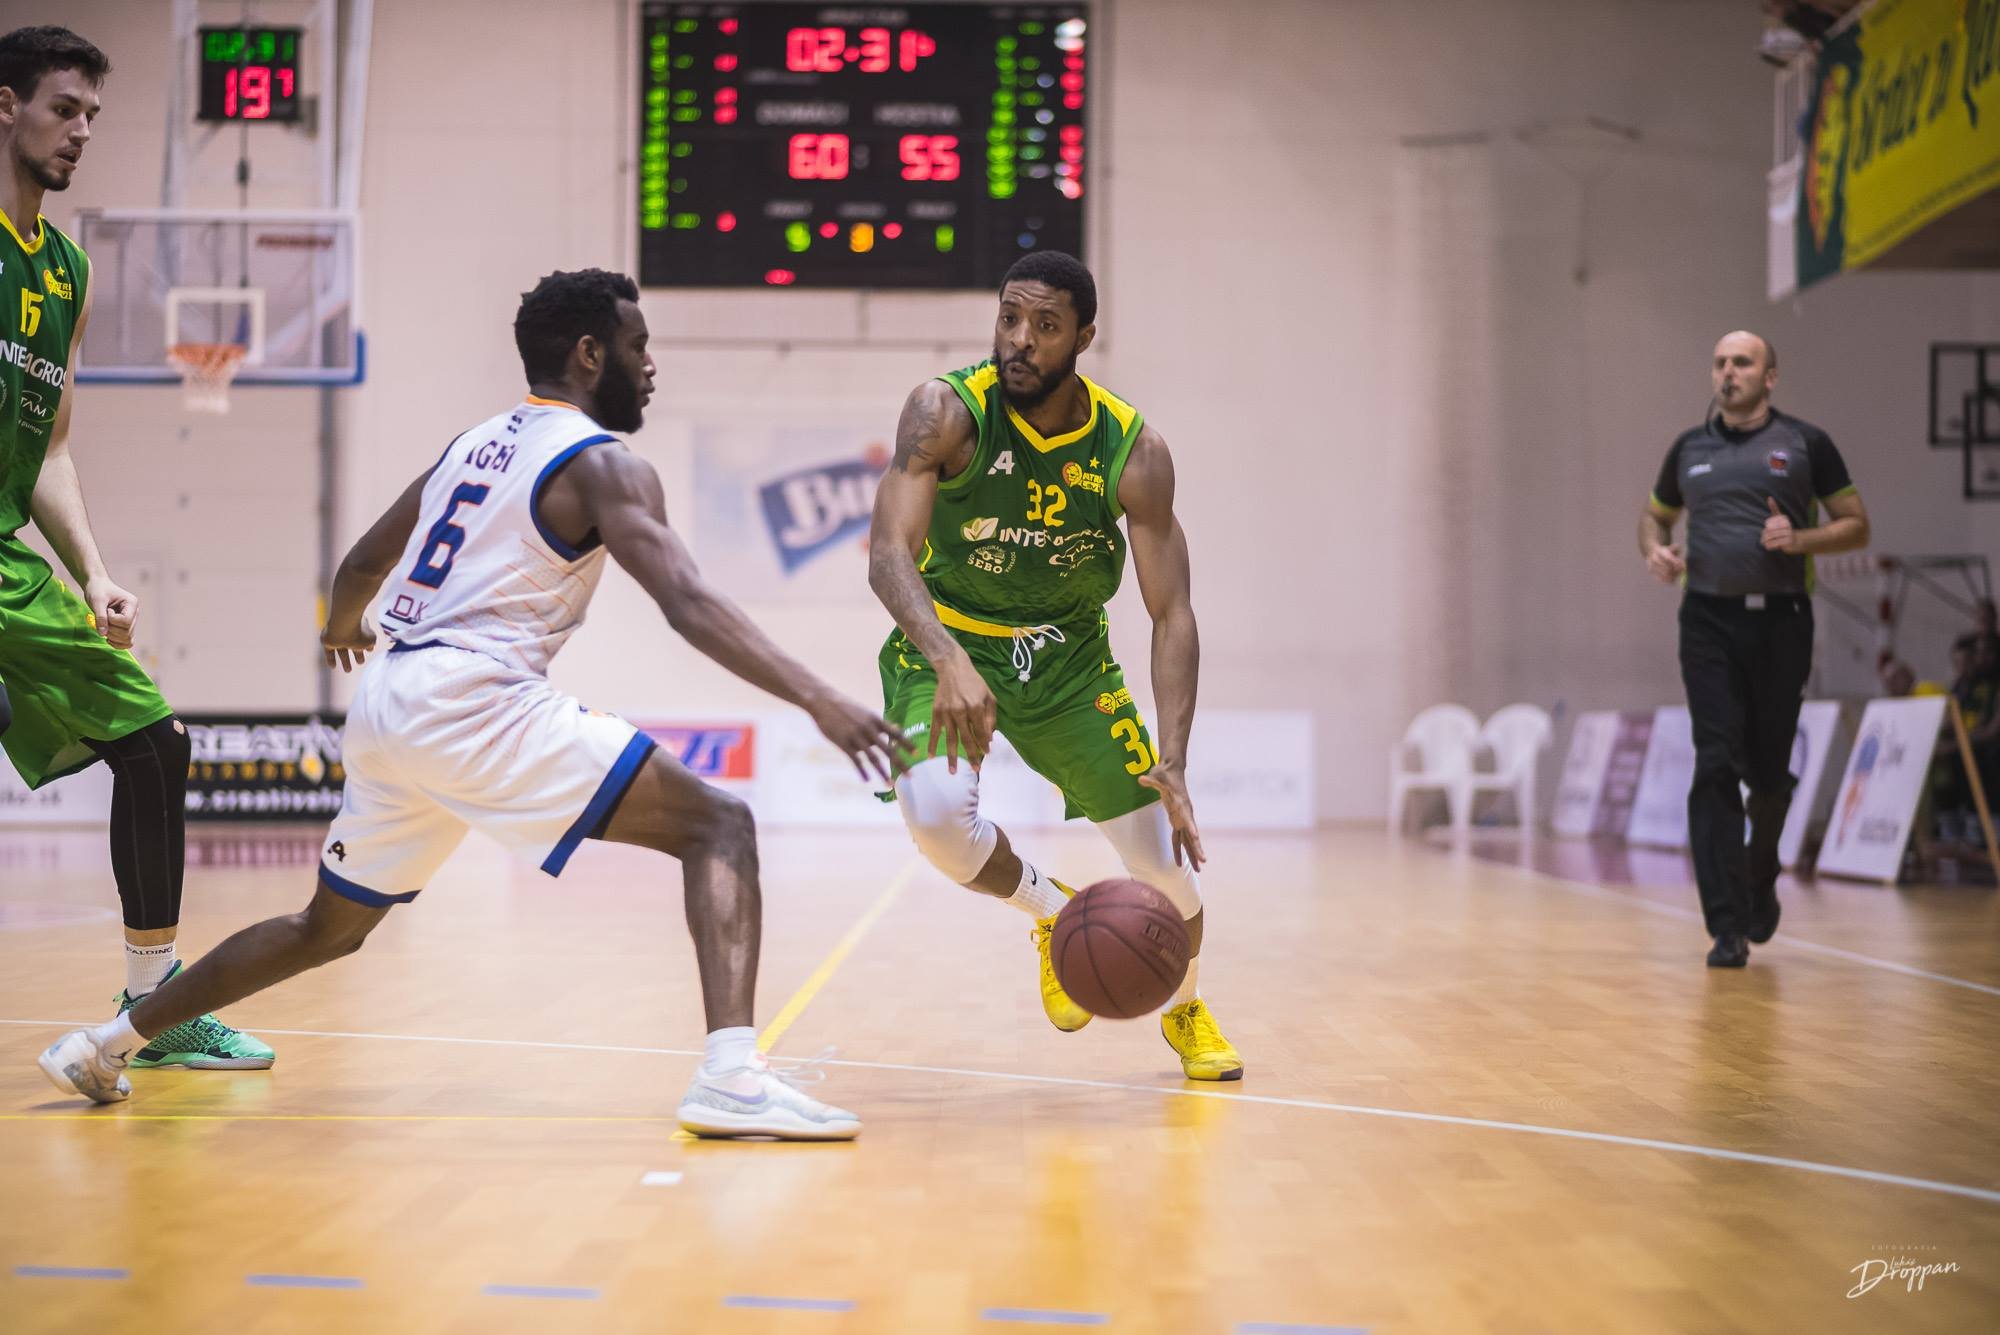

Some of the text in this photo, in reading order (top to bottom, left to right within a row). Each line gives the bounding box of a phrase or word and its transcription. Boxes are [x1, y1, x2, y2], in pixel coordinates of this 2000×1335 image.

[788, 133, 961, 181] 60 55
[21, 287, 44, 337] 15
[1026, 479, 1067, 527] 32
[407, 480, 491, 590] 6
